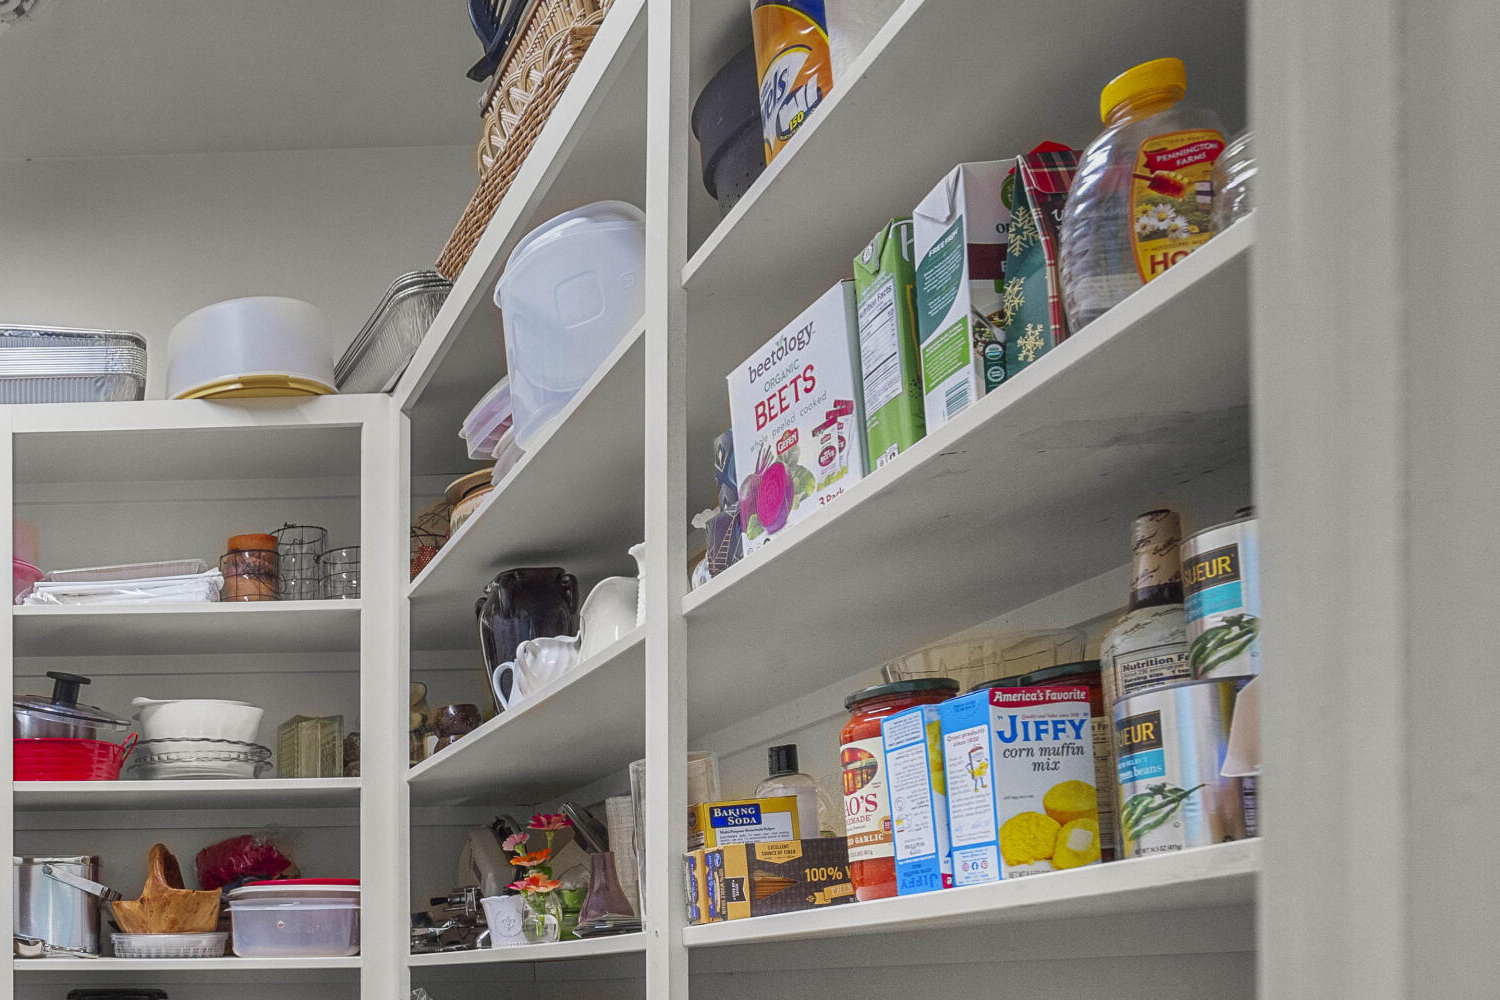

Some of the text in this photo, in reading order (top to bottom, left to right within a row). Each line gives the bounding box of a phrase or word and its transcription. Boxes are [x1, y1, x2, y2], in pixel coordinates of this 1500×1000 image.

[789, 111, 804, 131] 150
[1156, 141, 1219, 162] PENNINGTON
[1176, 152, 1207, 166] FARMS
[748, 321, 814, 384] beetology
[763, 358, 800, 393] ORGANIC
[754, 363, 816, 432] BEETS
[772, 415, 796, 440] peeled
[799, 390, 828, 417] cooked
[1122, 655, 1174, 673] Nutrition
[993, 689, 1087, 702] America's Favorite
[1003, 743, 1085, 758] corn muffin
[1032, 758, 1061, 771] mix
[1133, 764, 1162, 777] beans
[713, 806, 756, 818] BAKING
[727, 816, 757, 826] SODA
[855, 833, 885, 845] GARLIC
[804, 867, 843, 882] 100%
[900, 873, 939, 889] JIFFY
